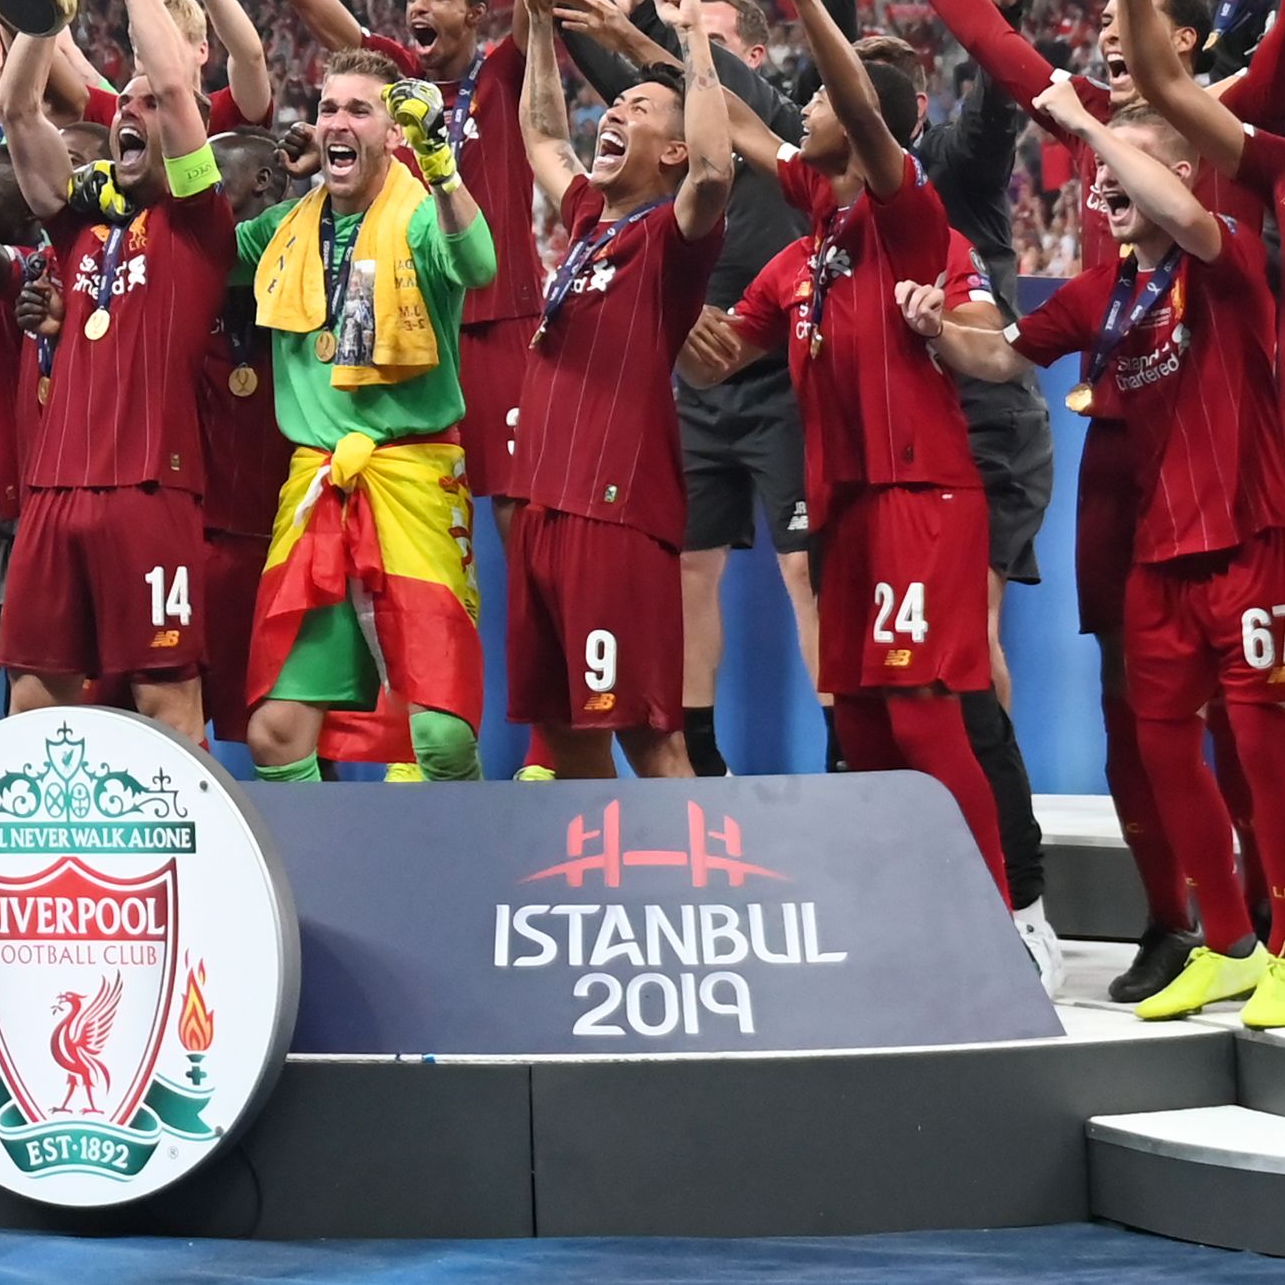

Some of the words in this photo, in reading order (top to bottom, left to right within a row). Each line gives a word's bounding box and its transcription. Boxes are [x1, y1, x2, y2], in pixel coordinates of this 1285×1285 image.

[145, 566, 192, 626] 14
[873, 582, 928, 643] 24
[150, 630, 180, 648] NB
[884, 649, 912, 666] NB
[585, 629, 617, 692] 9
[584, 693, 616, 710] NB
[13, 825, 71, 849] NEVER
[70, 825, 127, 849] WALK
[126, 825, 191, 849] ALONE
[103, 944, 158, 965] CLUB
[494, 902, 849, 968] ISTANBUL
[572, 971, 756, 1036] 2019
